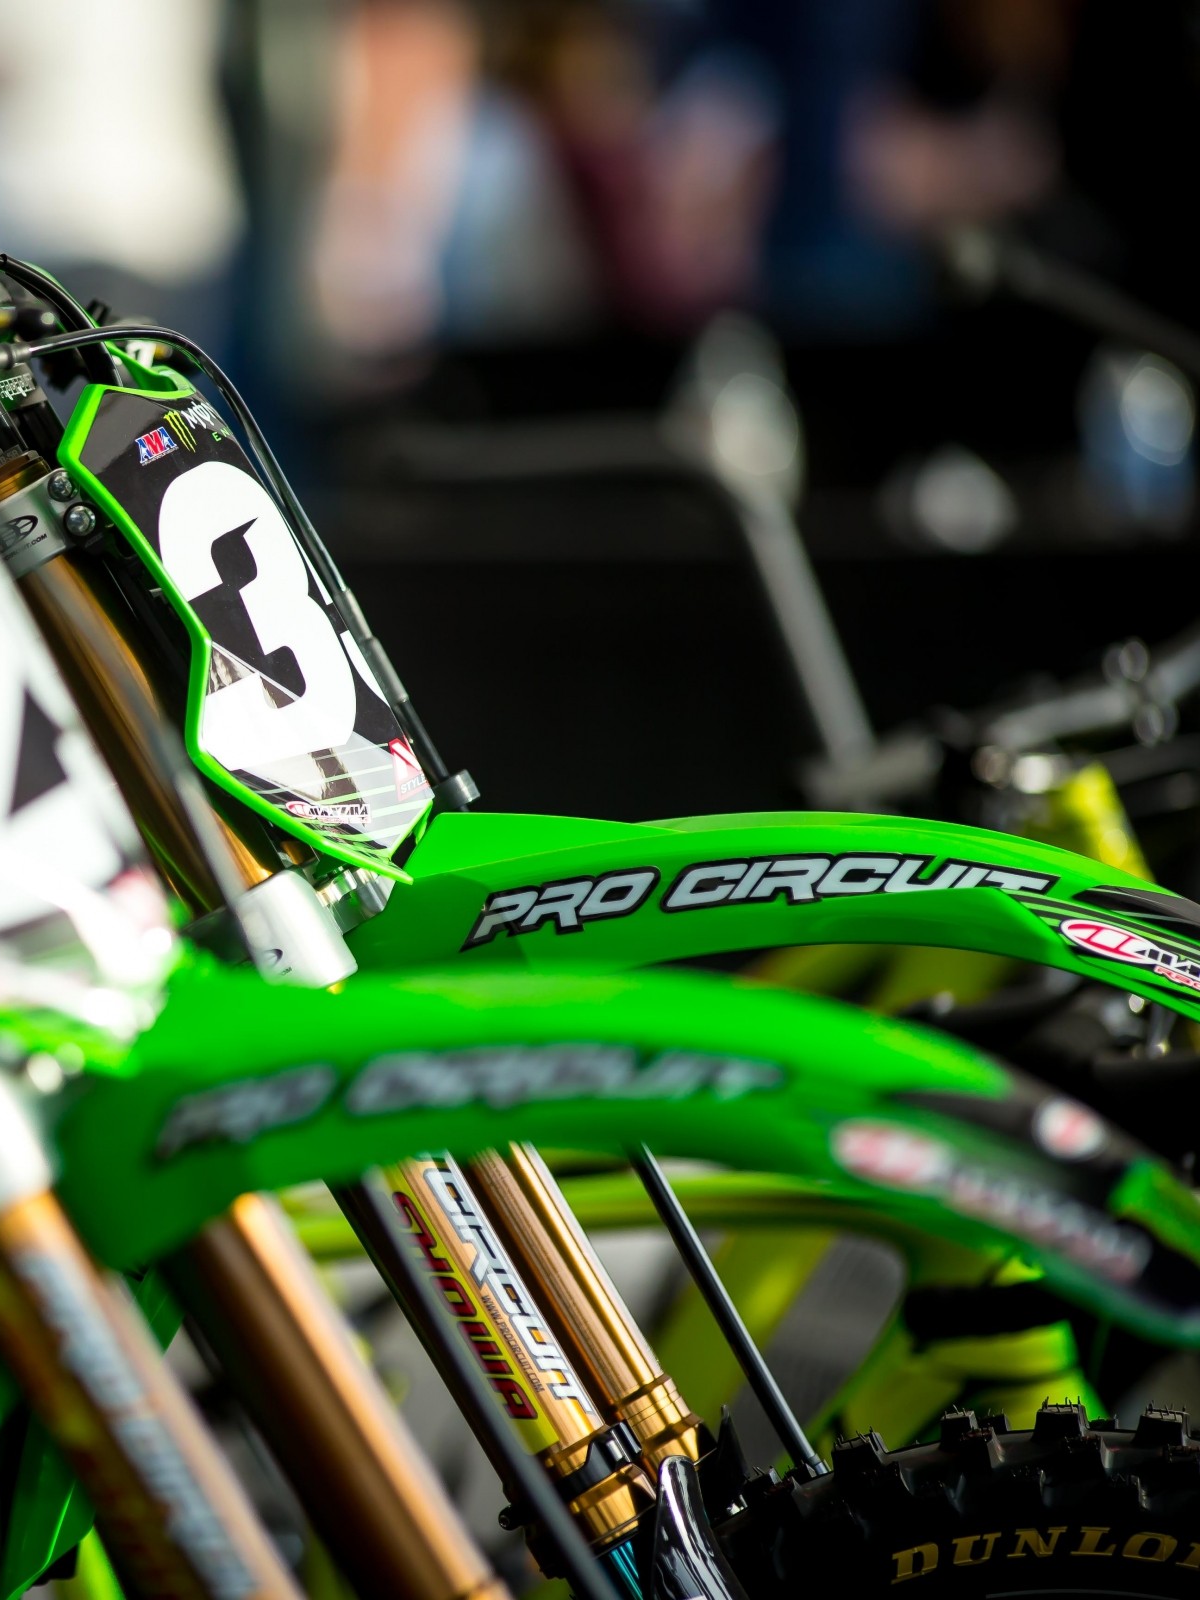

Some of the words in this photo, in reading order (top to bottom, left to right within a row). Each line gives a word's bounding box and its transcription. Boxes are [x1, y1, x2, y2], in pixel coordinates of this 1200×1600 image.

[135, 426, 178, 464] AMA
[158, 461, 390, 771] 3
[466, 866, 652, 948] PRO
[663, 853, 1057, 908] CIRCUIT
[392, 1190, 538, 1420] SHOWA
[423, 1168, 594, 1416] CIRCUIT
